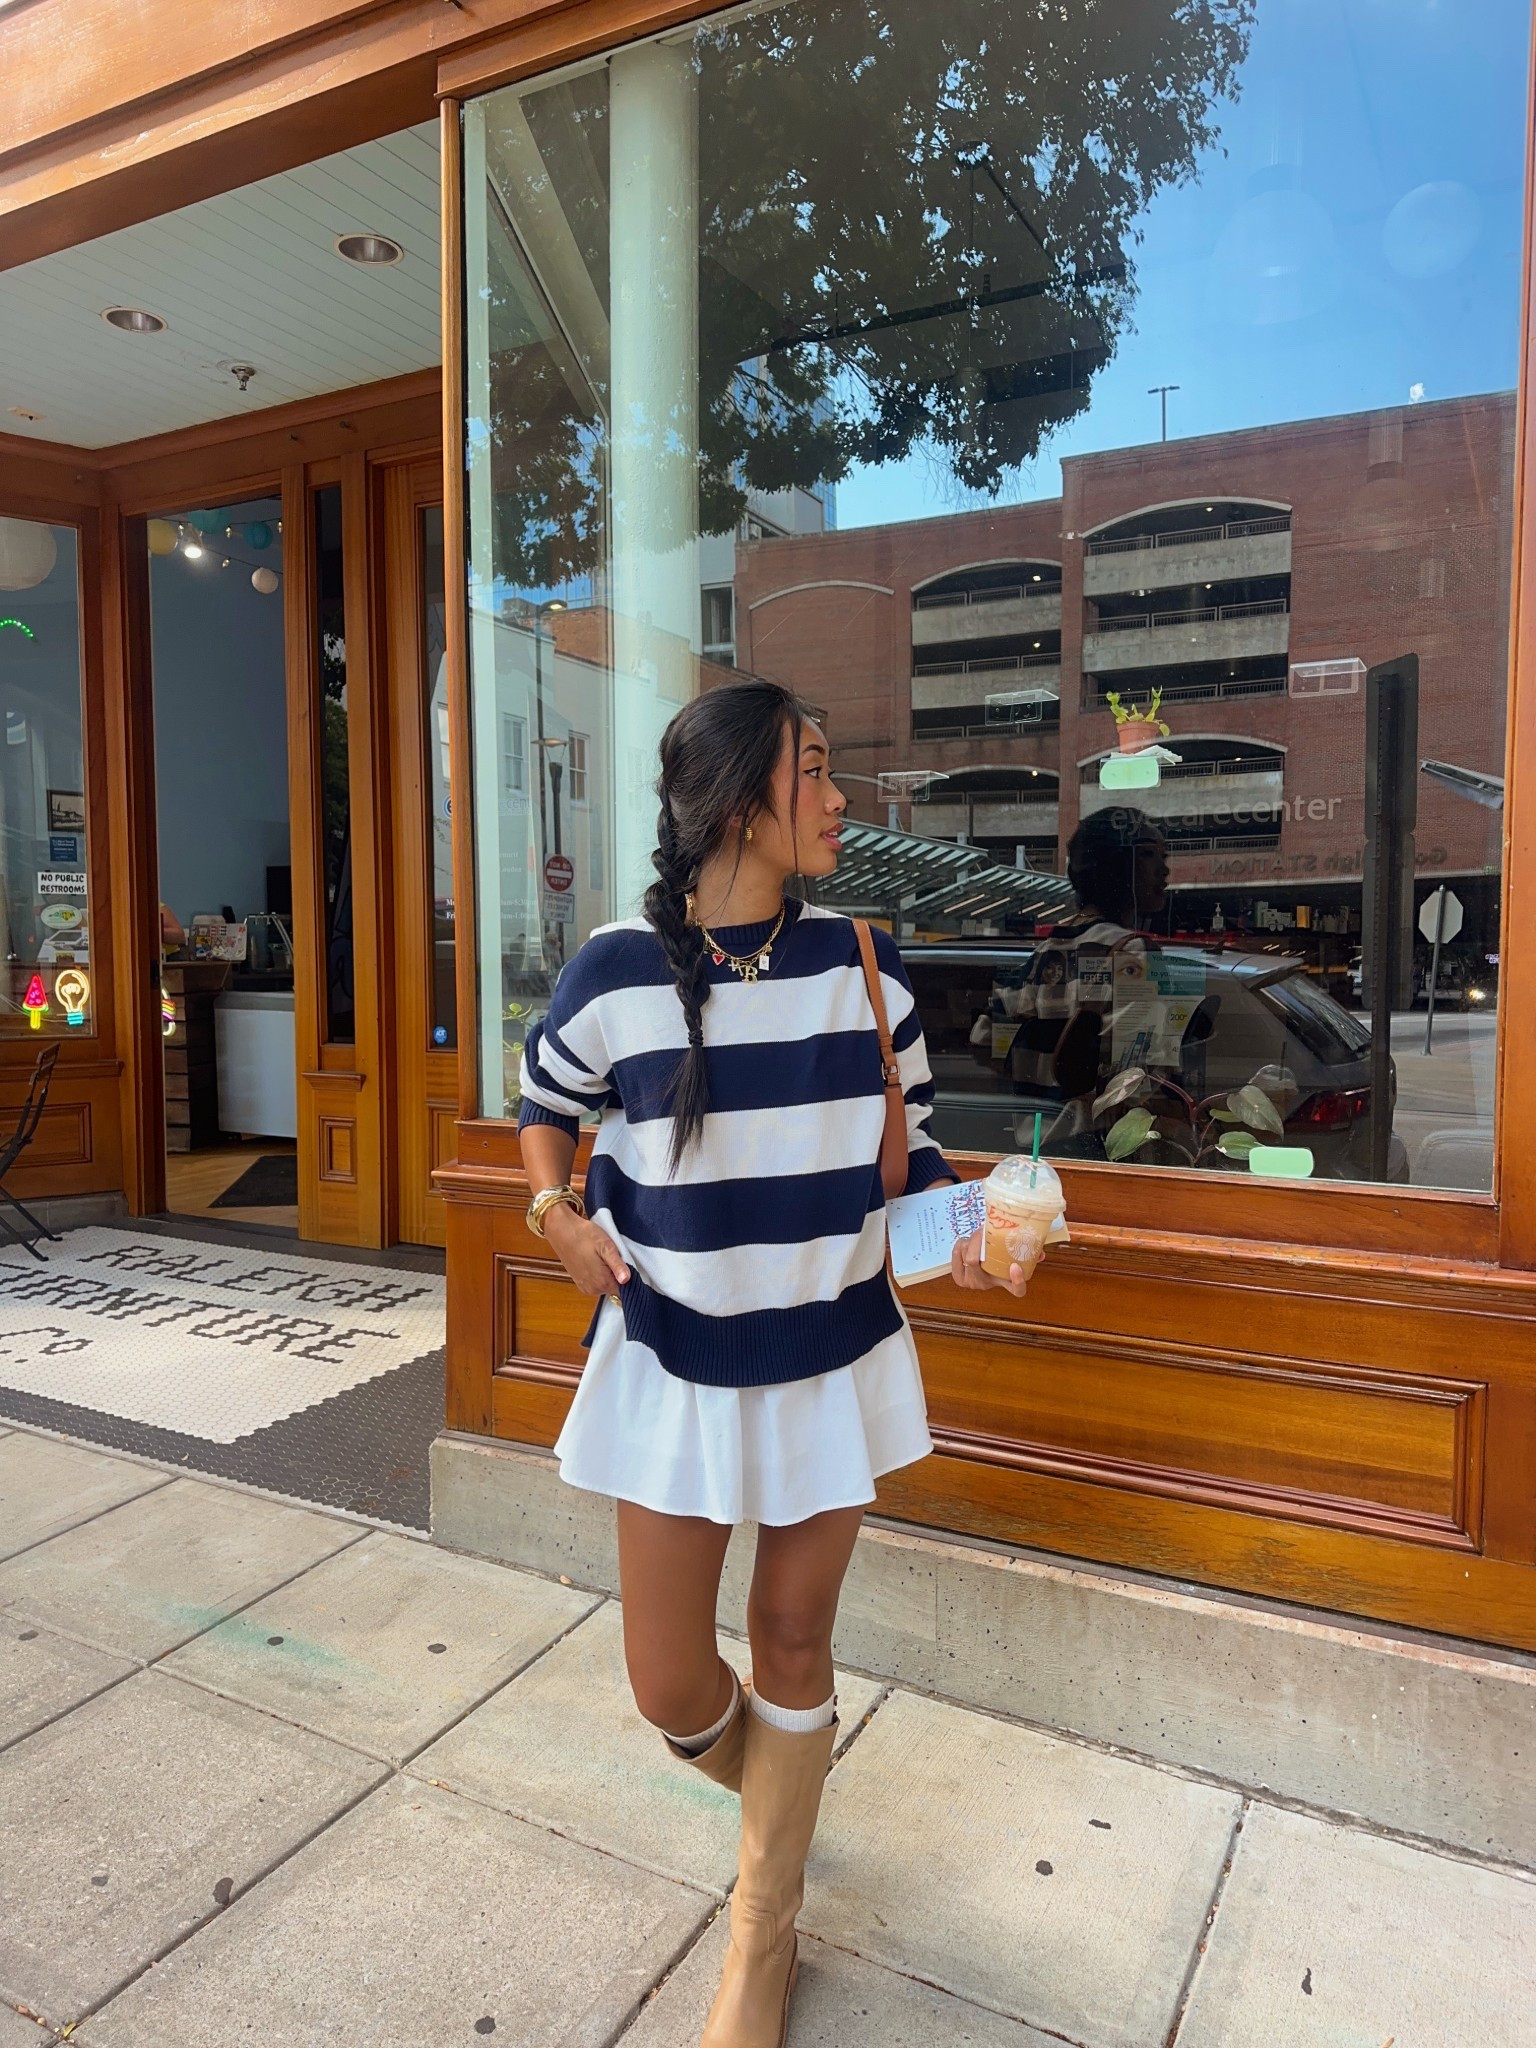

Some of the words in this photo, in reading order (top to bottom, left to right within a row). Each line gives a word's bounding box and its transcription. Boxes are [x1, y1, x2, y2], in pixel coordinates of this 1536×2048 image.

[41, 874, 53, 882] NO
[41, 885, 85, 893] RESTROOMS
[1084, 973, 1109, 983] FREE
[78, 1245, 433, 1313] RALEIGH
[0, 1263, 401, 1364] URNITURE
